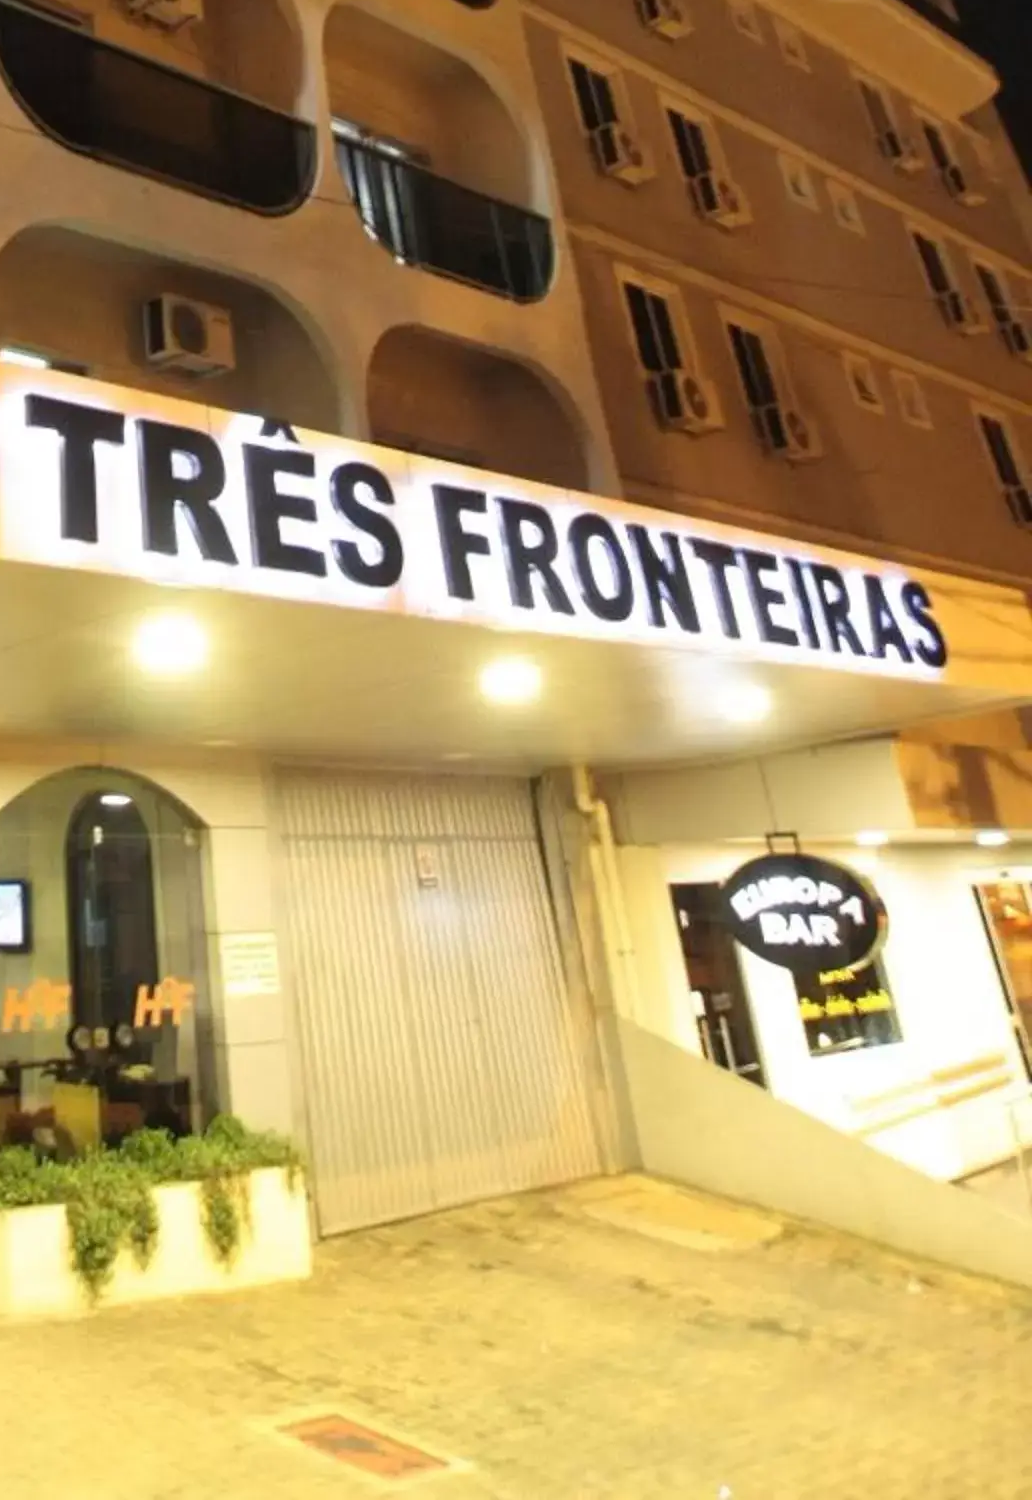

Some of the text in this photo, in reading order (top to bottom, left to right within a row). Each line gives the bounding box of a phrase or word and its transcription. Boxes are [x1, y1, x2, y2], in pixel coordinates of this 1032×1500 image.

[25, 393, 404, 589] TRÊS
[430, 483, 947, 668] FRONTEIRAS
[759, 912, 842, 947] BAR
